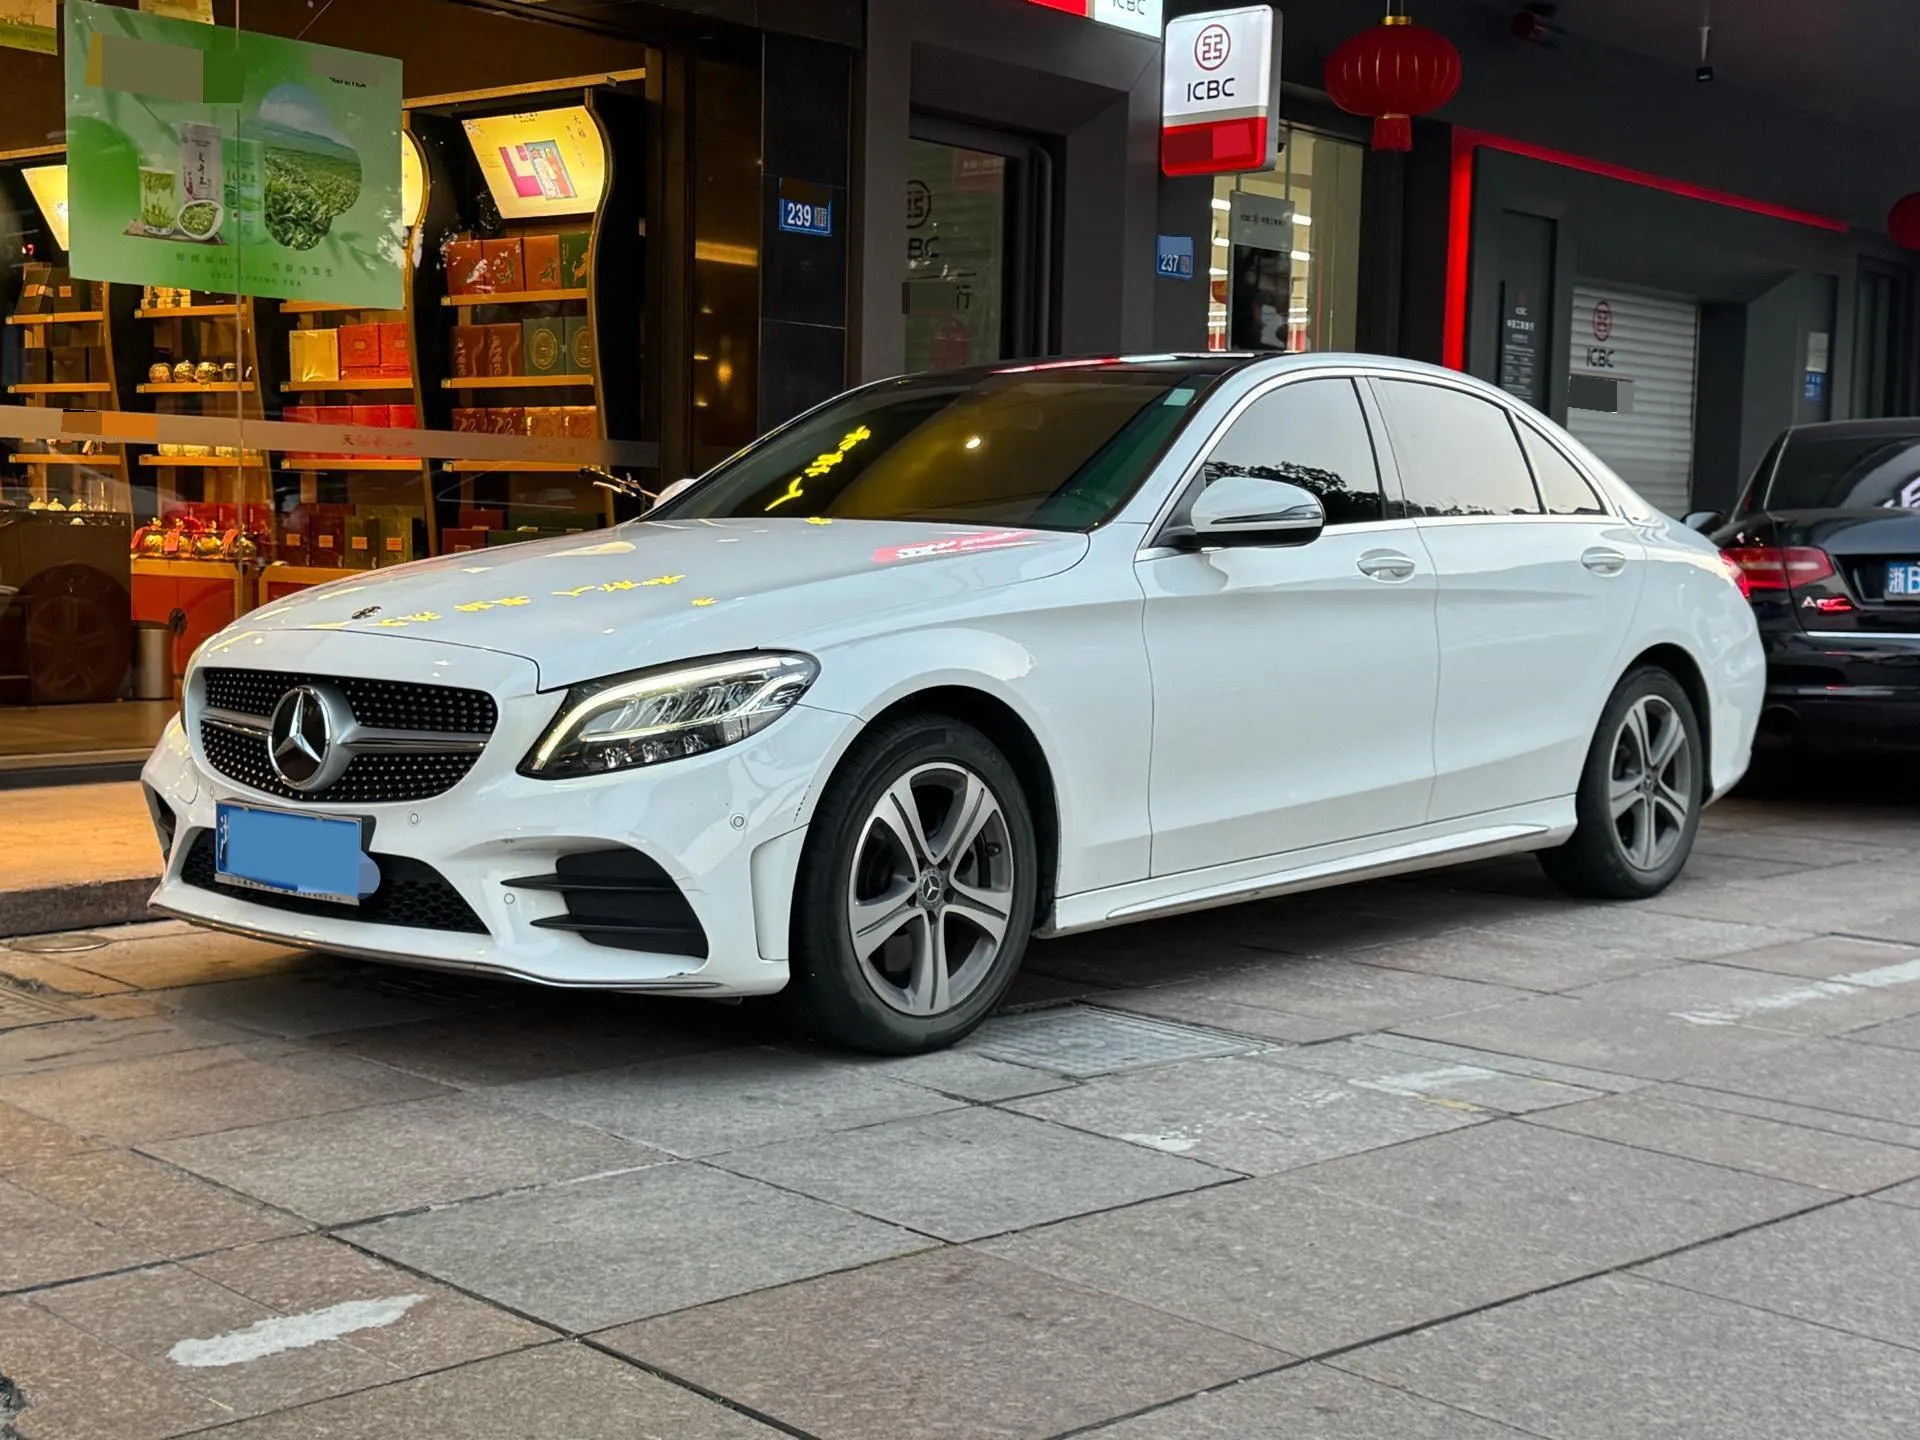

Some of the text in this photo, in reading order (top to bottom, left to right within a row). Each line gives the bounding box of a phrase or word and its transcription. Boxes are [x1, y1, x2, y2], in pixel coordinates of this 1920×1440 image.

[1187, 77, 1235, 102] ICBC
[787, 202, 812, 227] 239
[1161, 254, 1179, 272] 237
[1586, 347, 1615, 369] ICBC
